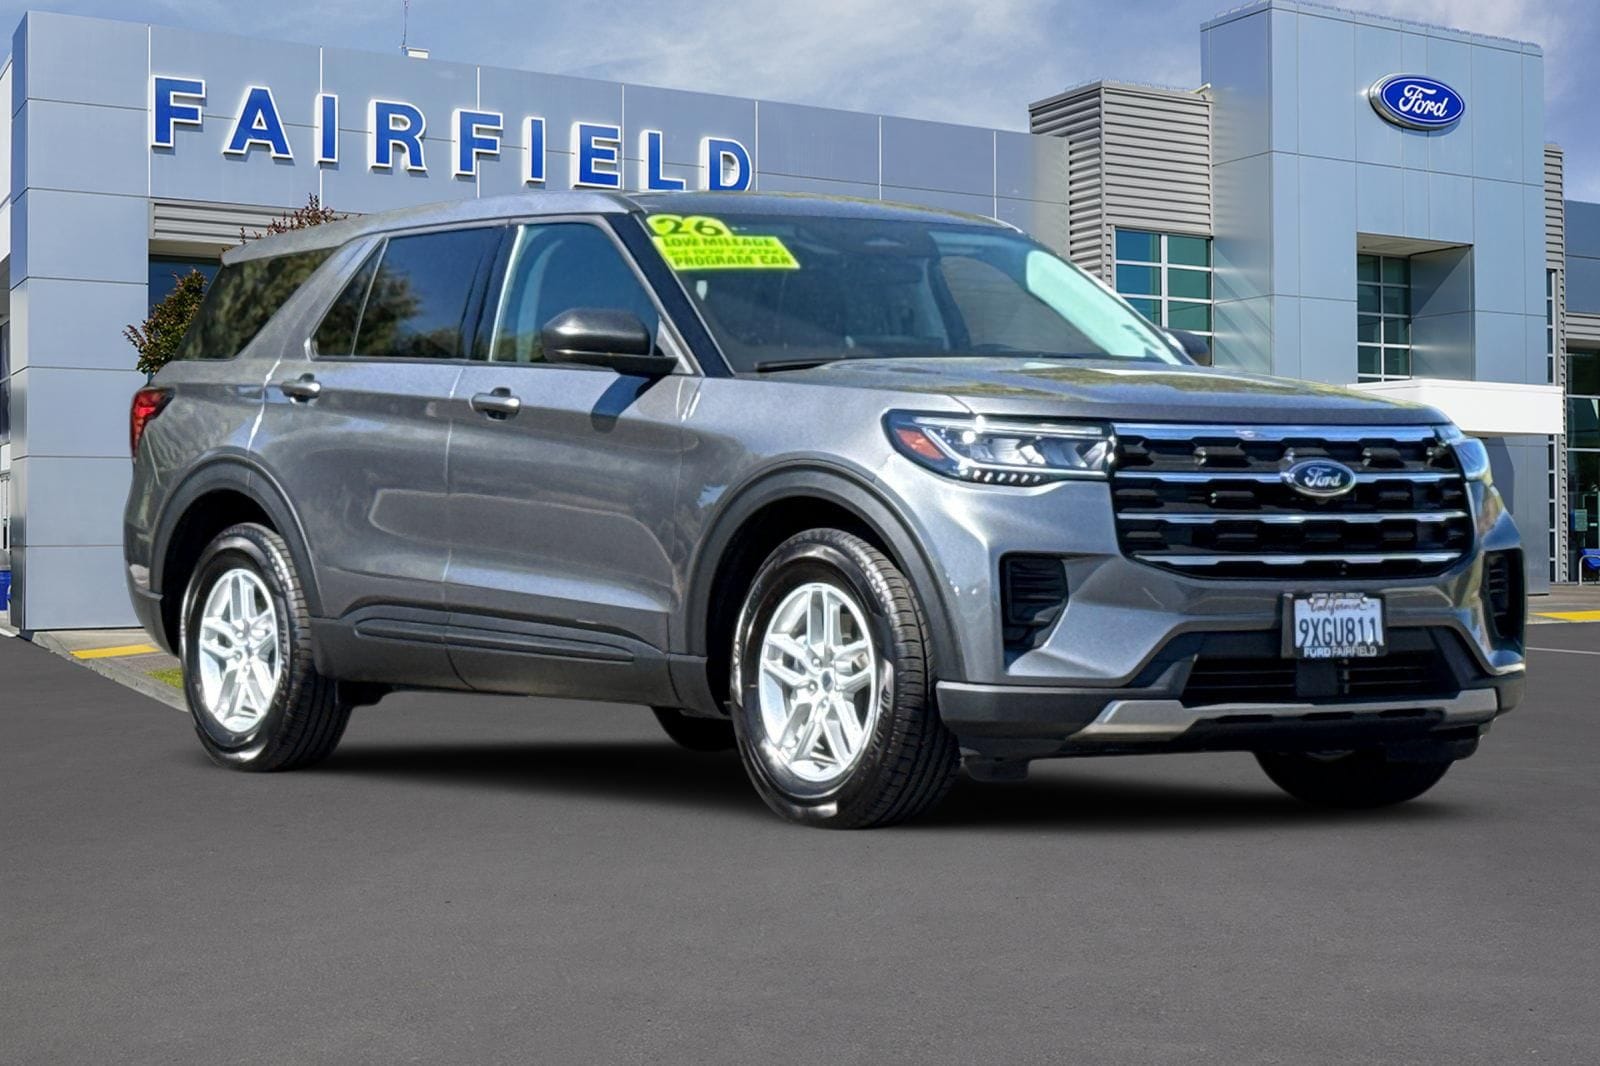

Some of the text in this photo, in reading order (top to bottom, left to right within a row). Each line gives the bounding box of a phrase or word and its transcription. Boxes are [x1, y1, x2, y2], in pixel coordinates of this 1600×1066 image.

[1398, 84, 1449, 117] Ford
[150, 76, 752, 191] FAIRFIELD
[655, 218, 724, 237] 26
[663, 237, 776, 248] LOW MILEAGE
[674, 254, 791, 266] PROGRAM CAR
[1304, 466, 1342, 488] Ford
[1299, 616, 1377, 647] 9XGU811
[1303, 647, 1331, 658] FORD
